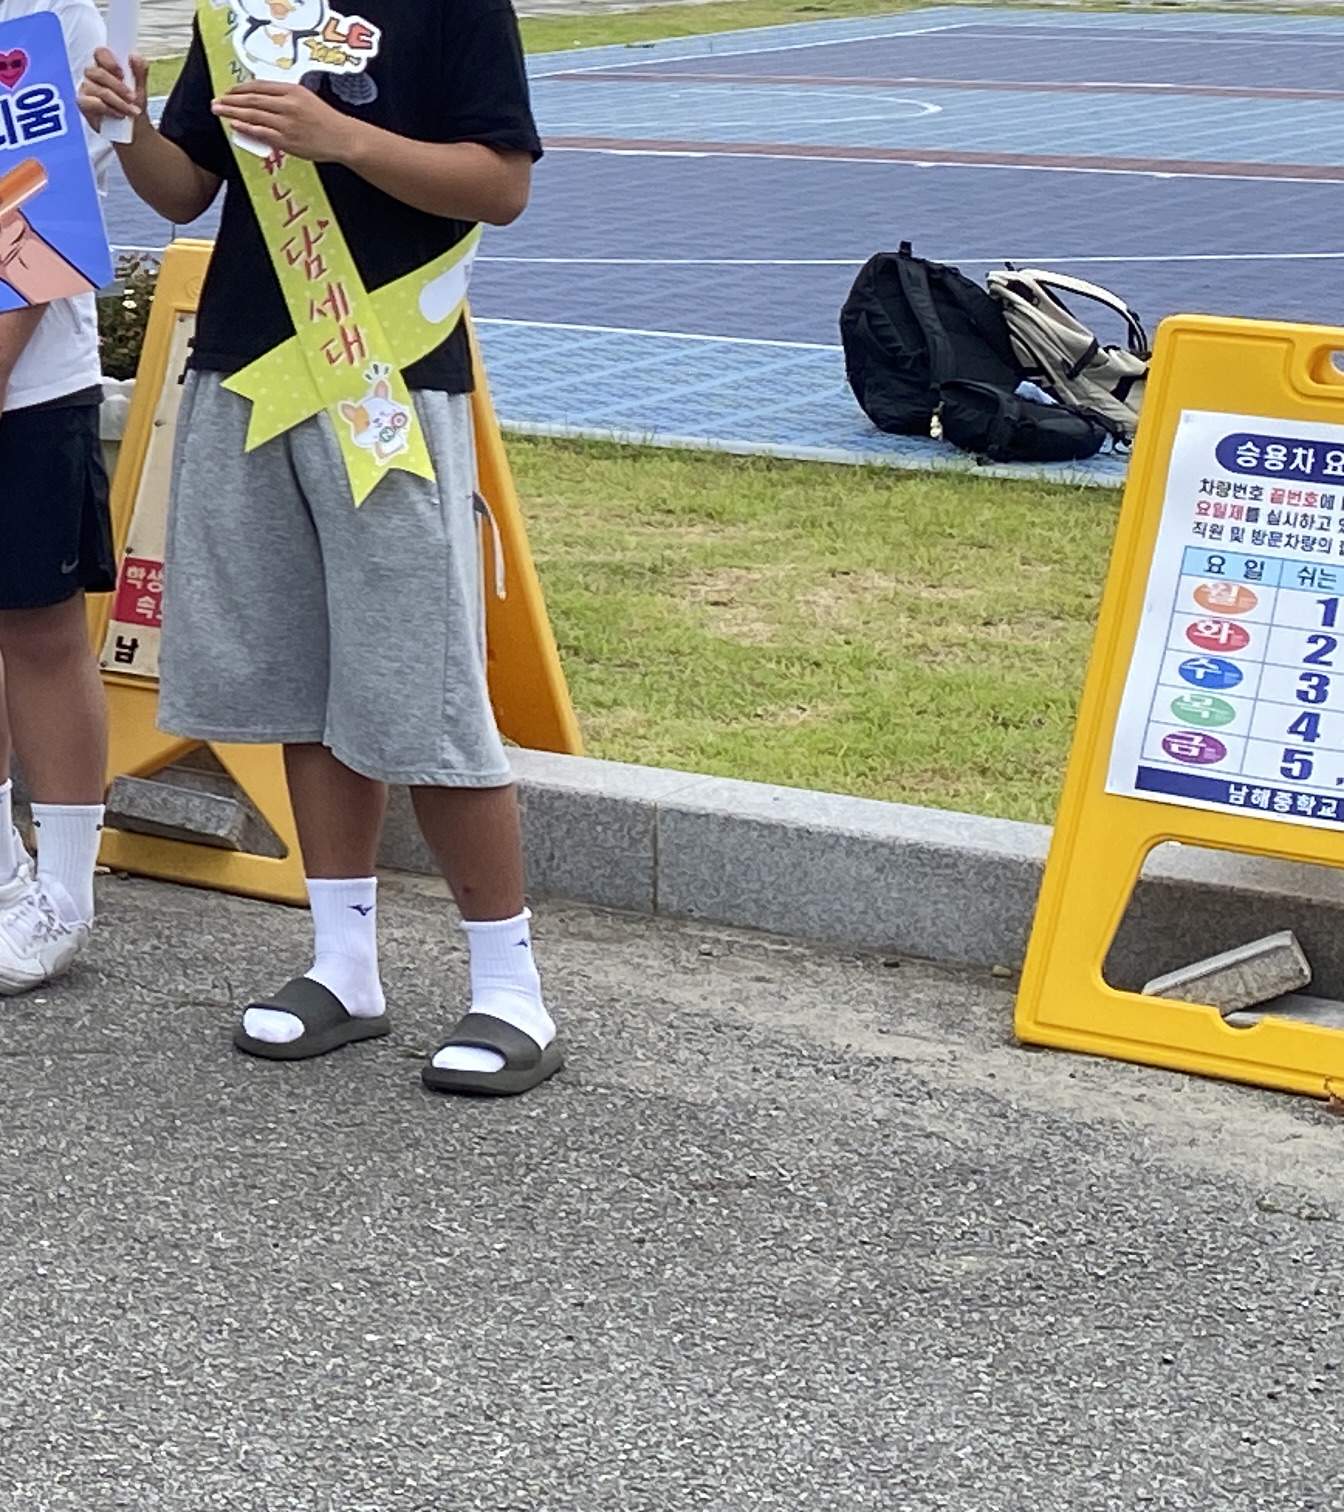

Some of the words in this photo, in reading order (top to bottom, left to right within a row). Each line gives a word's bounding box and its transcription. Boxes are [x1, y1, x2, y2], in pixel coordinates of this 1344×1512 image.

[1236, 440, 1316, 475] 승용차
[1198, 477, 1265, 502] 차량번호
[1195, 499, 1261, 524] 요일제를
[1267, 508, 1332, 532] 실시하고
[1192, 521, 1225, 541] 직원
[1229, 526, 1246, 544] 및
[1250, 528, 1334, 555] 방문차량의
[1297, 565, 1337, 590] 쉬는
[1316, 597, 1340, 628] 1
[1302, 634, 1339, 667] 2
[1295, 671, 1331, 705] 3
[1286, 710, 1322, 743] 4
[1279, 747, 1314, 781] 5
[1228, 783, 1338, 818] 남해중학교
